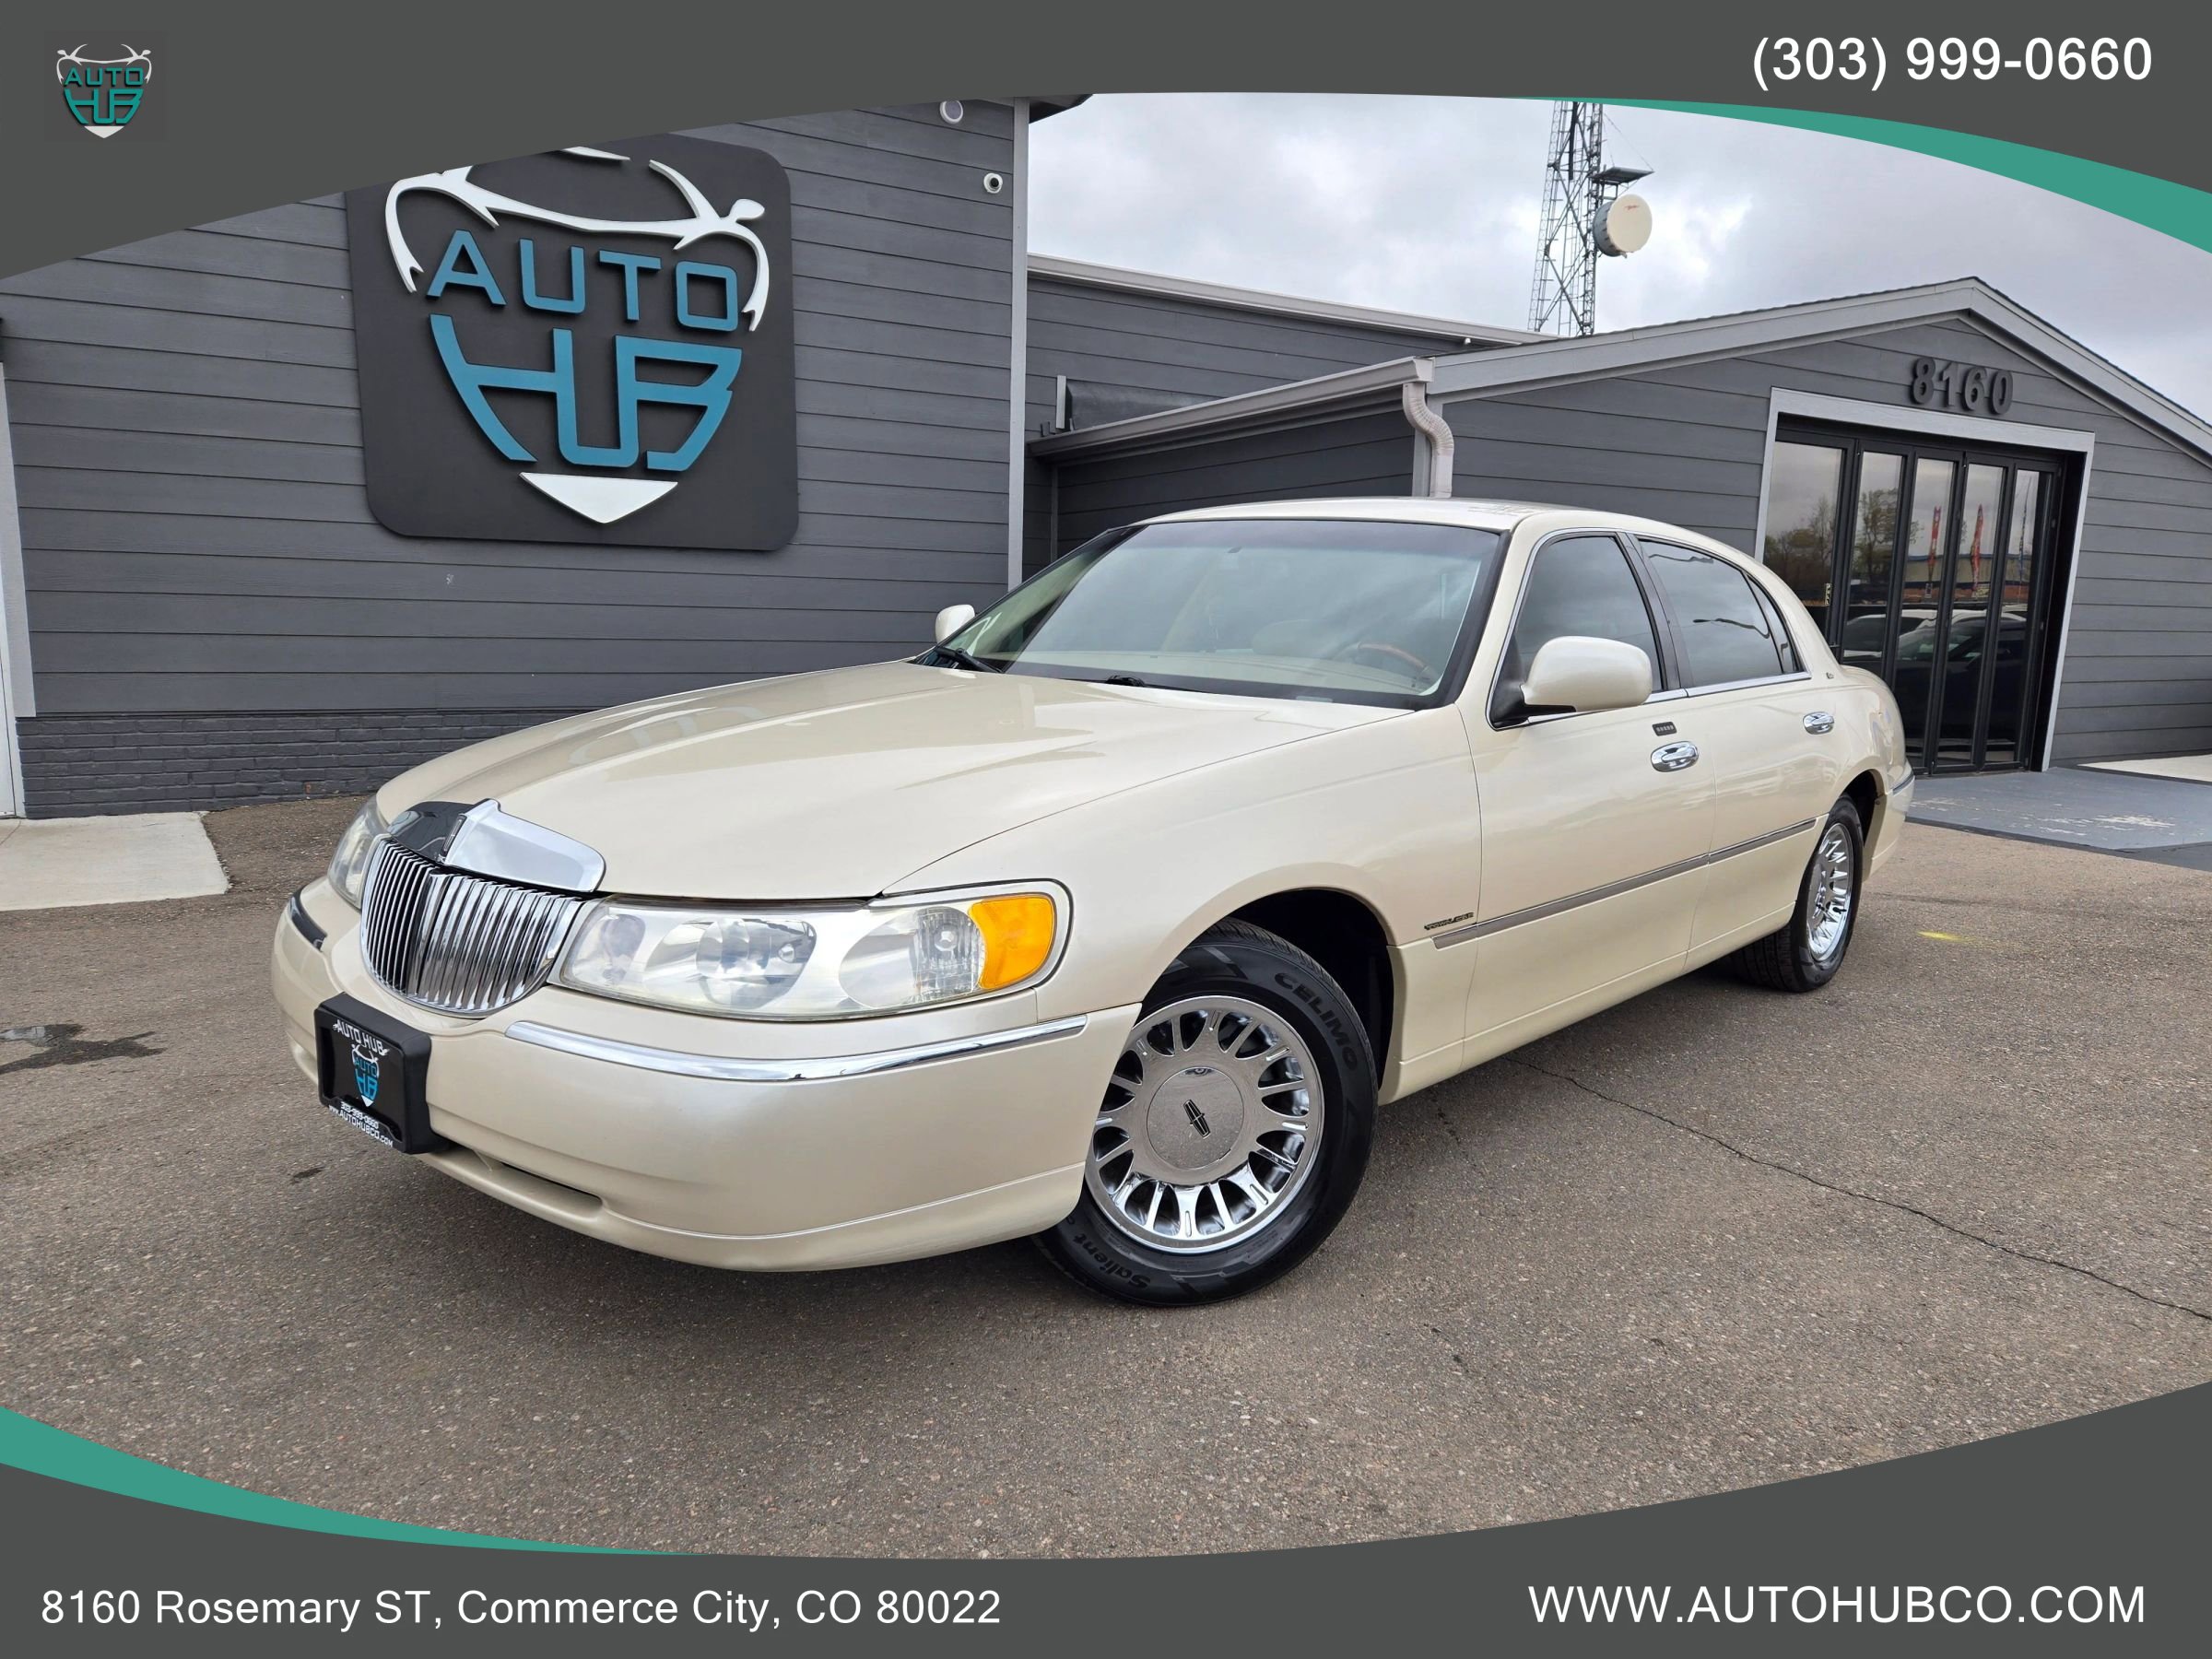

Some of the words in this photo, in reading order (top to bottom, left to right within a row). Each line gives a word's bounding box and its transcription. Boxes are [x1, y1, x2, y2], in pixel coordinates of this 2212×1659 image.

[428, 229, 739, 332] AUTO
[430, 314, 743, 472] HUB
[1911, 357, 2013, 415] 8160
[335, 1018, 360, 1043] AUTO
[361, 1033, 384, 1055] HUB
[1275, 972, 1358, 1071] CELIMO
[1073, 1233, 1150, 1288] Salient
